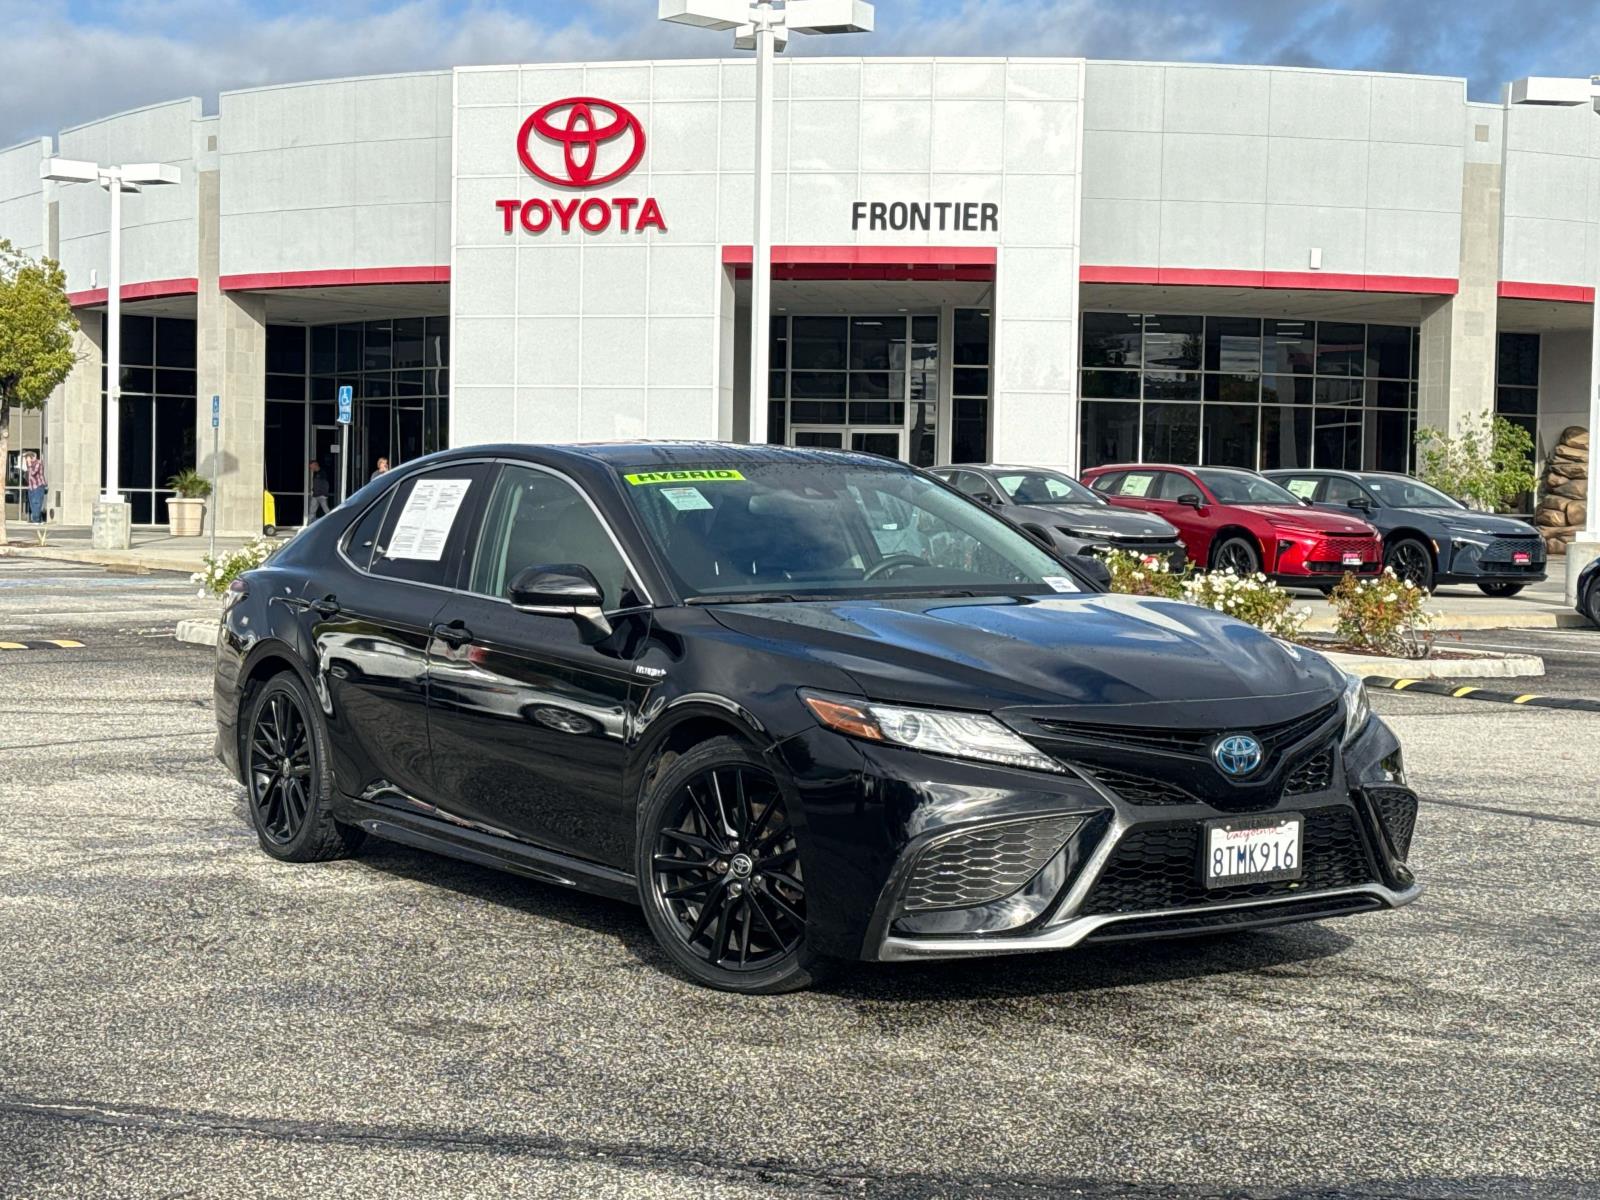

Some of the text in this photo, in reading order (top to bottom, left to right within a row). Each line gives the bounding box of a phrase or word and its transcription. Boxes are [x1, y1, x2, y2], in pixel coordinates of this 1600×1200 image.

[495, 197, 668, 234] TOYOTA
[852, 201, 999, 232] FRONTIER
[637, 470, 733, 482] HYBRID
[1213, 839, 1295, 876] 8TMK916
